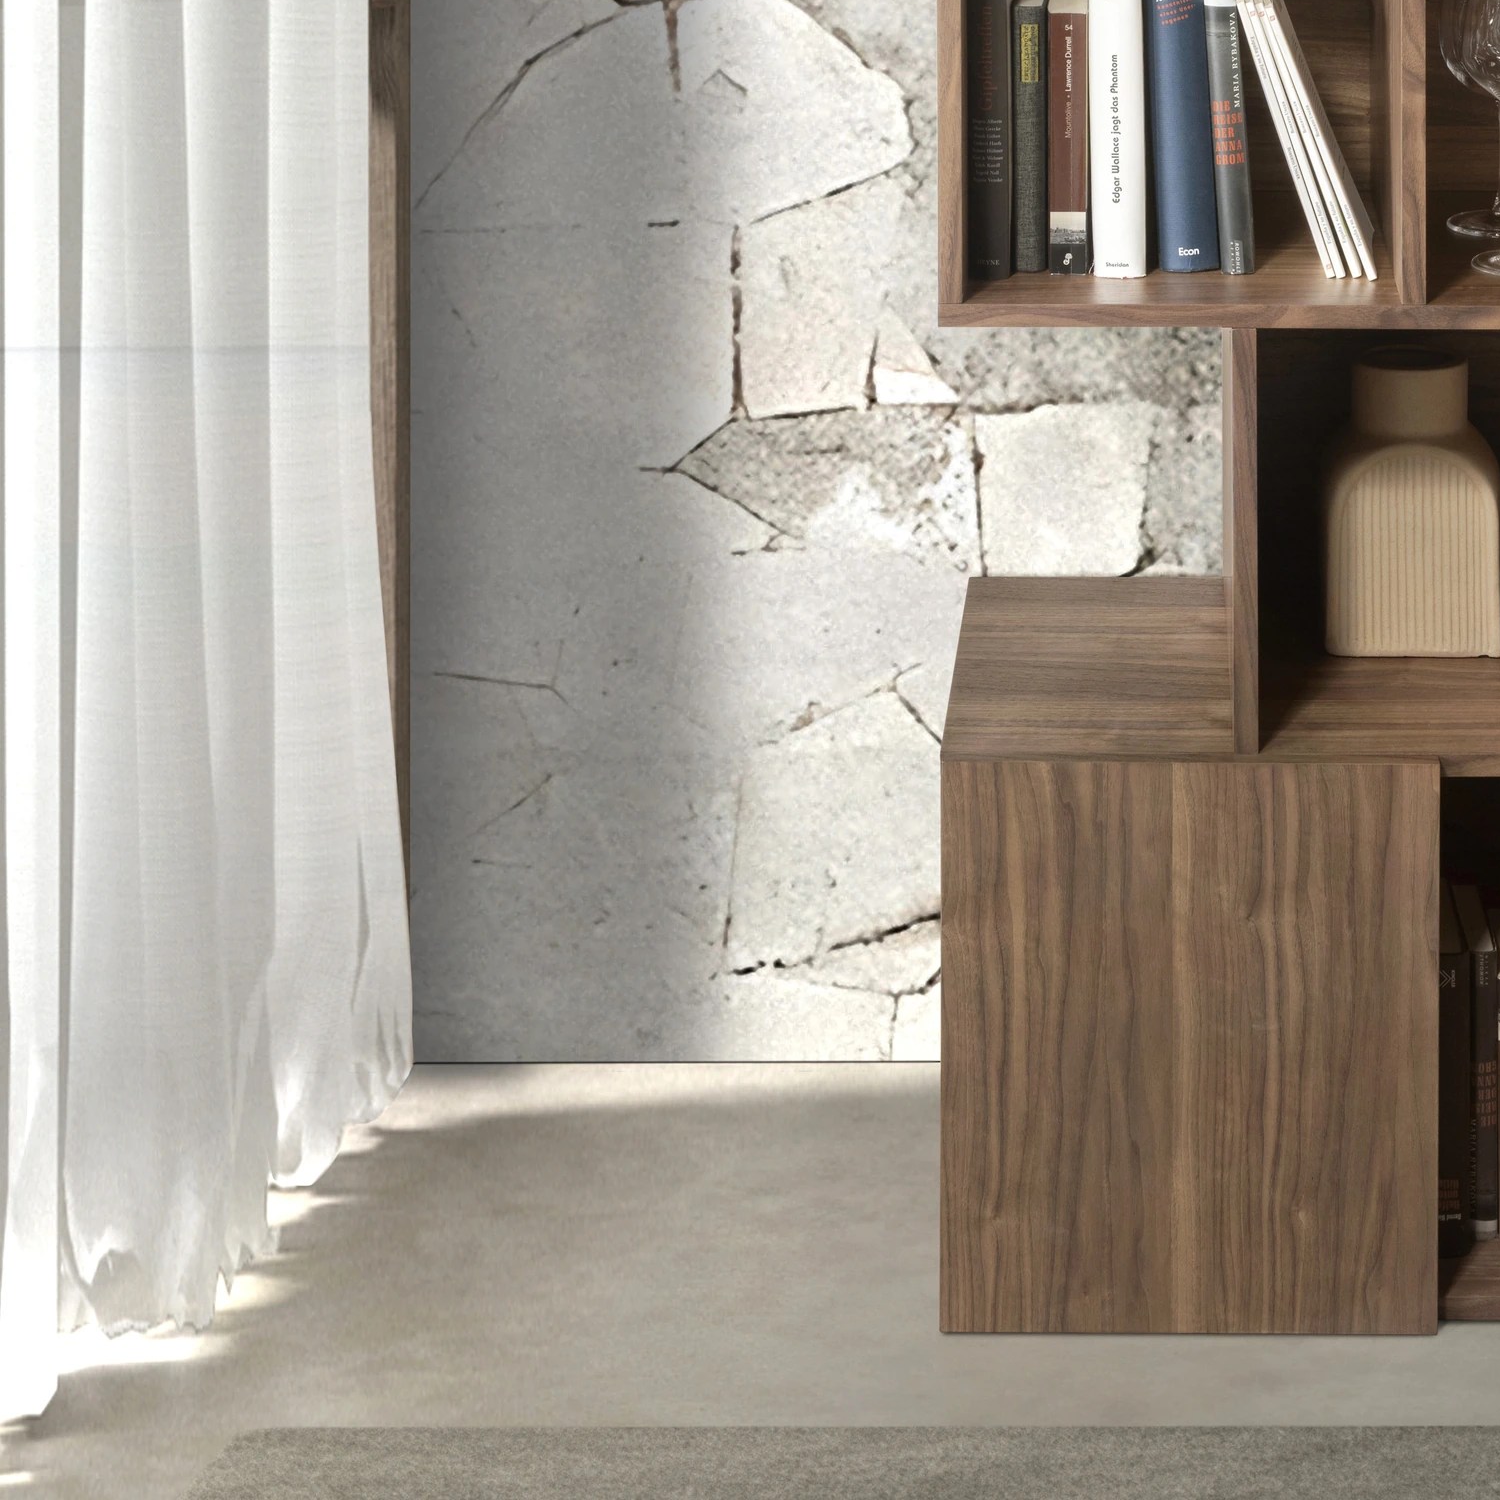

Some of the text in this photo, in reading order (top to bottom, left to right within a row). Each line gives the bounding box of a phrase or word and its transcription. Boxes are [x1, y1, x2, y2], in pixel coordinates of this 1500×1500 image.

[1229, 11, 1240, 108] MARIA RYBAKOVA
[1213, 100, 1230, 112] DIE
[1064, 101, 1072, 138] Mountolive
[1213, 111, 1243, 125] REISE
[1110, 54, 1122, 204] Edgar Wallace jagt das Phantom
[1215, 127, 1234, 139] DER
[1215, 139, 1243, 152] ANNA
[1216, 152, 1245, 165] GROM
[1178, 247, 1200, 256] Econ
